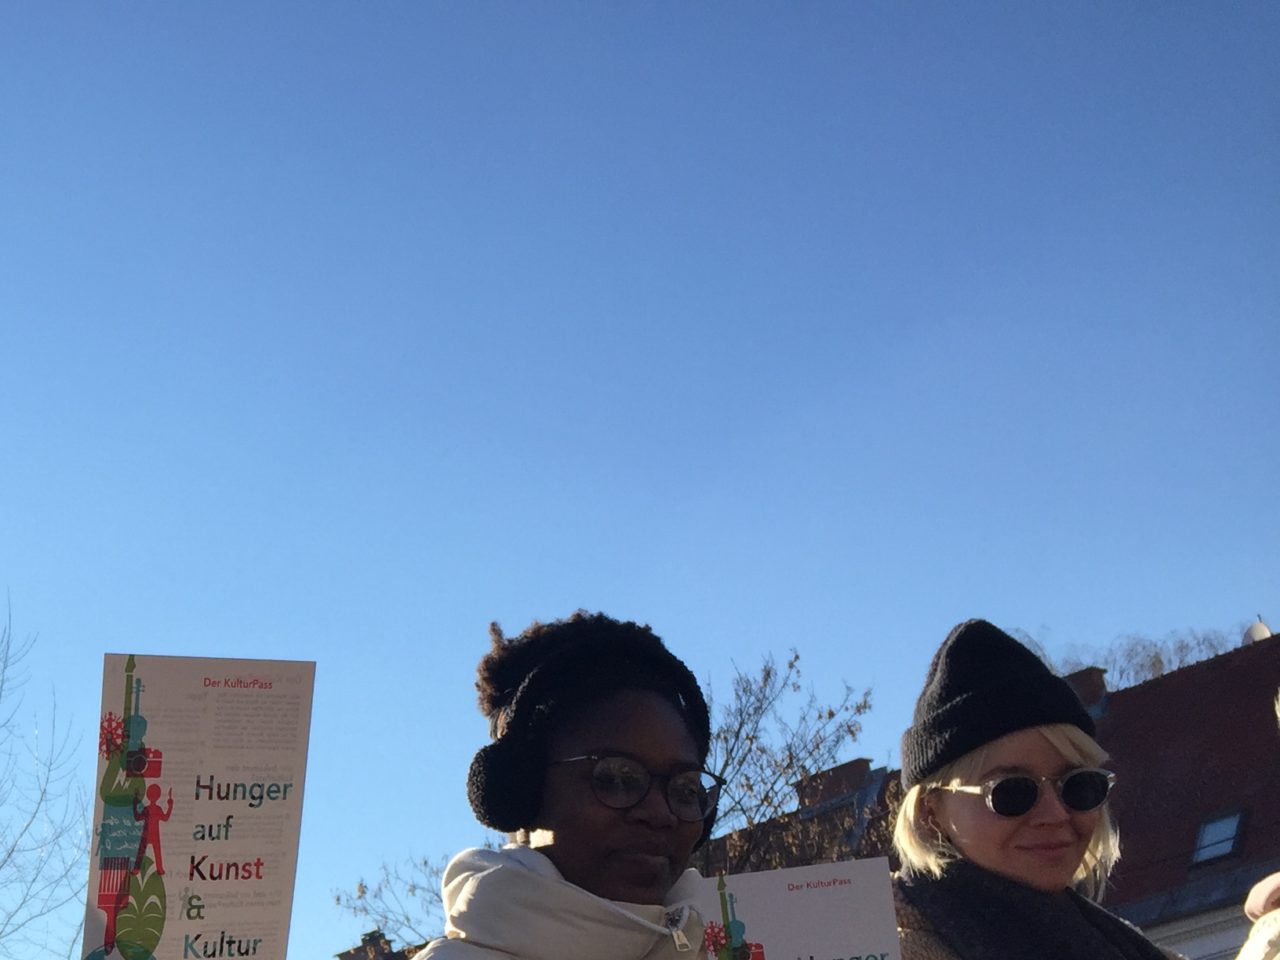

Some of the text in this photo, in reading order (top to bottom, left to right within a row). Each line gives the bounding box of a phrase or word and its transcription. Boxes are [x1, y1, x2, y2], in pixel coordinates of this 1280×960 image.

[203, 677, 221, 688] Der
[224, 678, 273, 689] KulturPass
[194, 774, 293, 808] Hunger
[192, 815, 234, 841] auf
[188, 855, 264, 881] Kunst
[787, 878, 852, 892] Der KulturPass
[185, 894, 205, 920] &
[183, 931, 263, 960] Kultur
